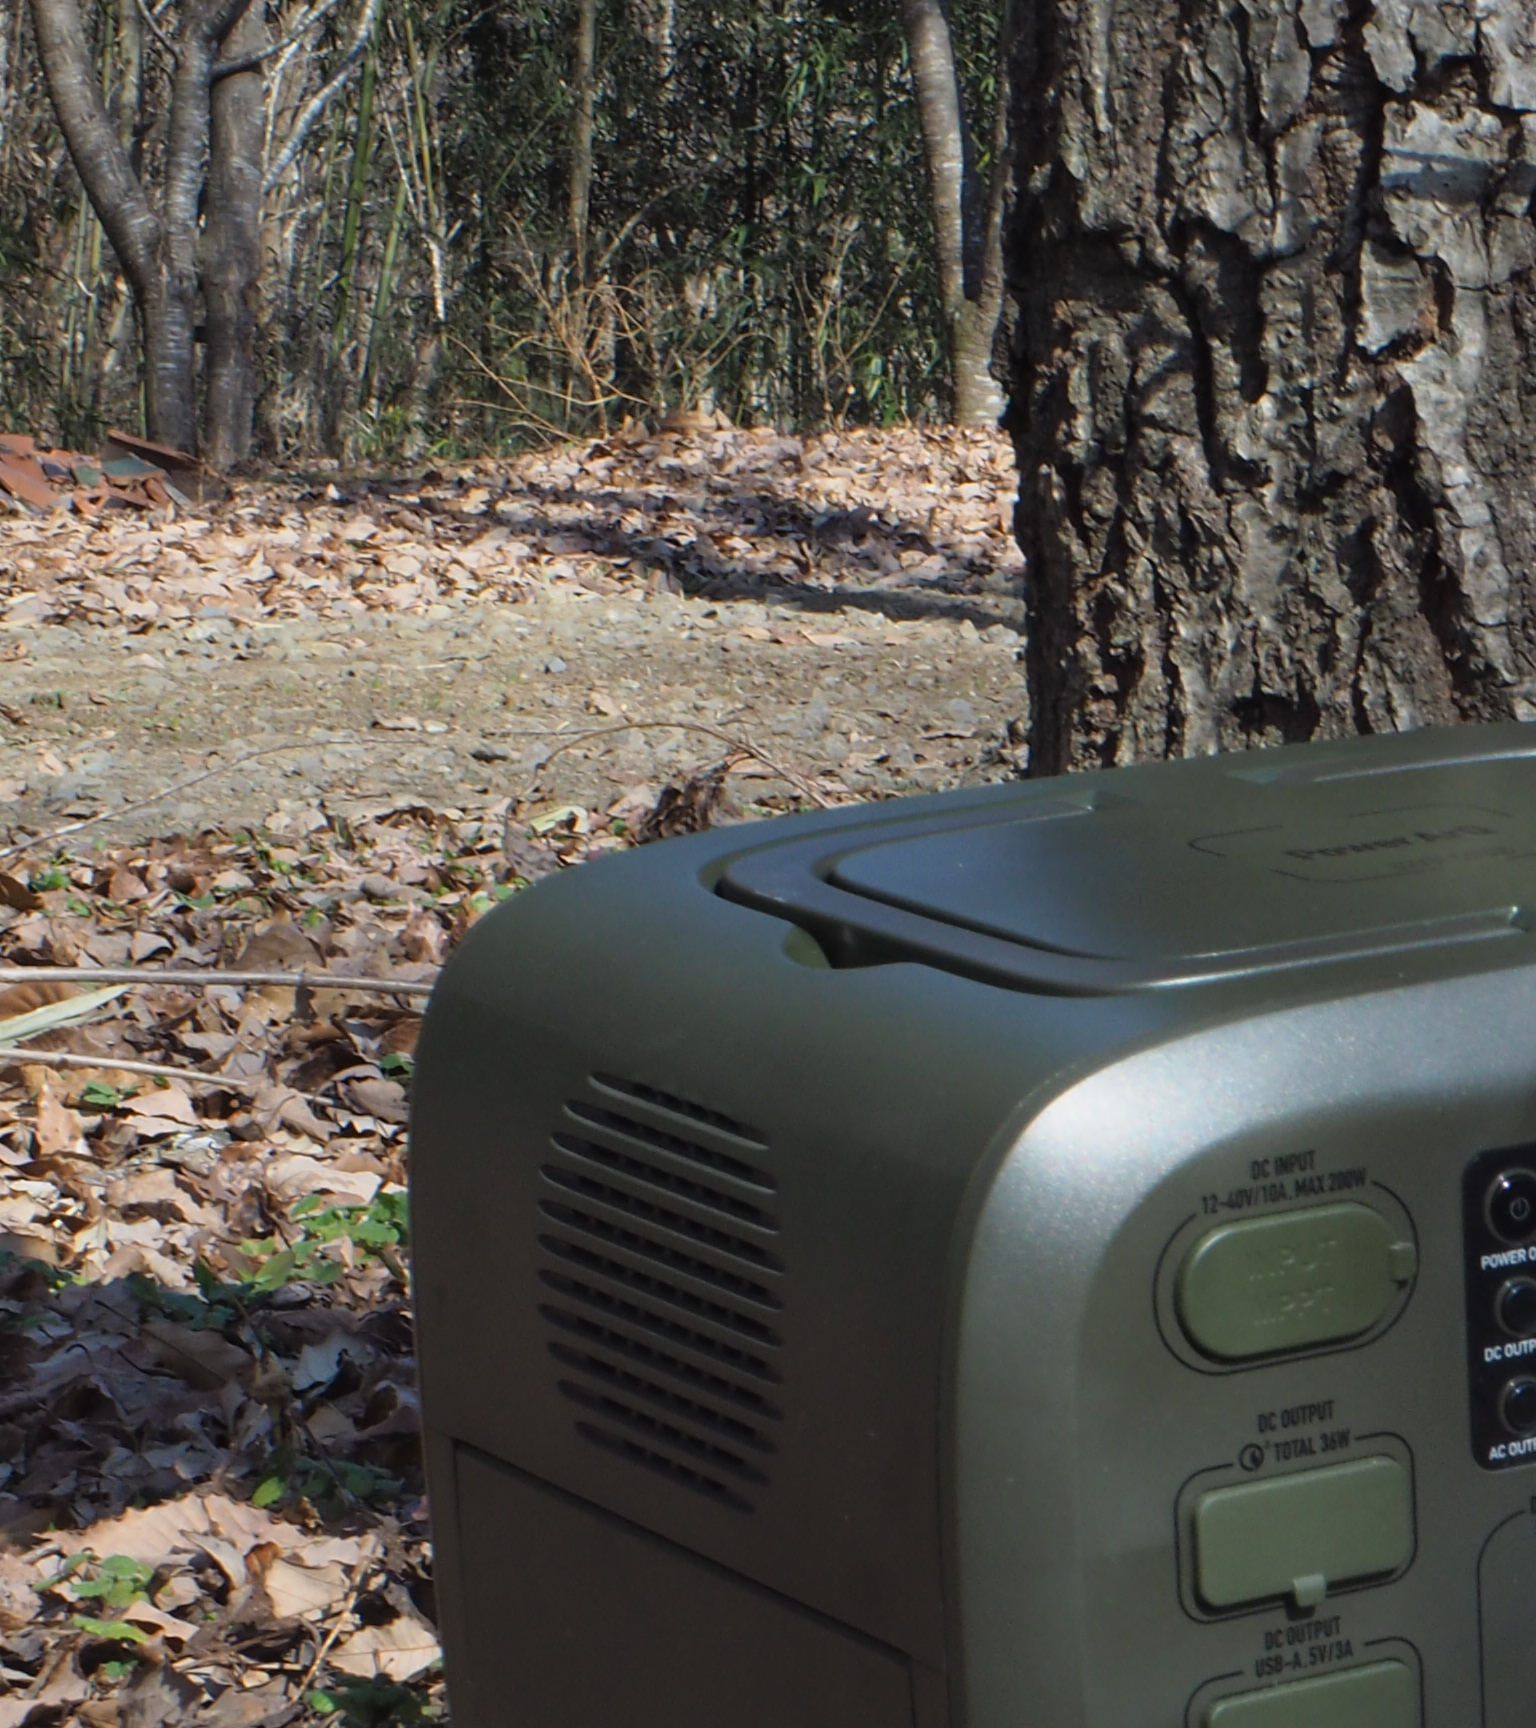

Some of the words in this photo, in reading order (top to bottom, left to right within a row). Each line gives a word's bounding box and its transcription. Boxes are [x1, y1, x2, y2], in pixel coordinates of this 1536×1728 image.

[1251, 1158, 1271, 1181] DC
[1274, 1150, 1316, 1177] INPUT
[1293, 1169, 1326, 1199] MAX
[1480, 1247, 1528, 1271] POWER
[1483, 1345, 1503, 1363] DC
[1257, 1411, 1277, 1434] DC
[1280, 1399, 1335, 1429] OUTPUT
[1274, 1436, 1317, 1463] TOTAL
[1488, 1447, 1508, 1461] AC
[1264, 1628, 1284, 1651] DC
[1286, 1615, 1341, 1646] OUTPUT
